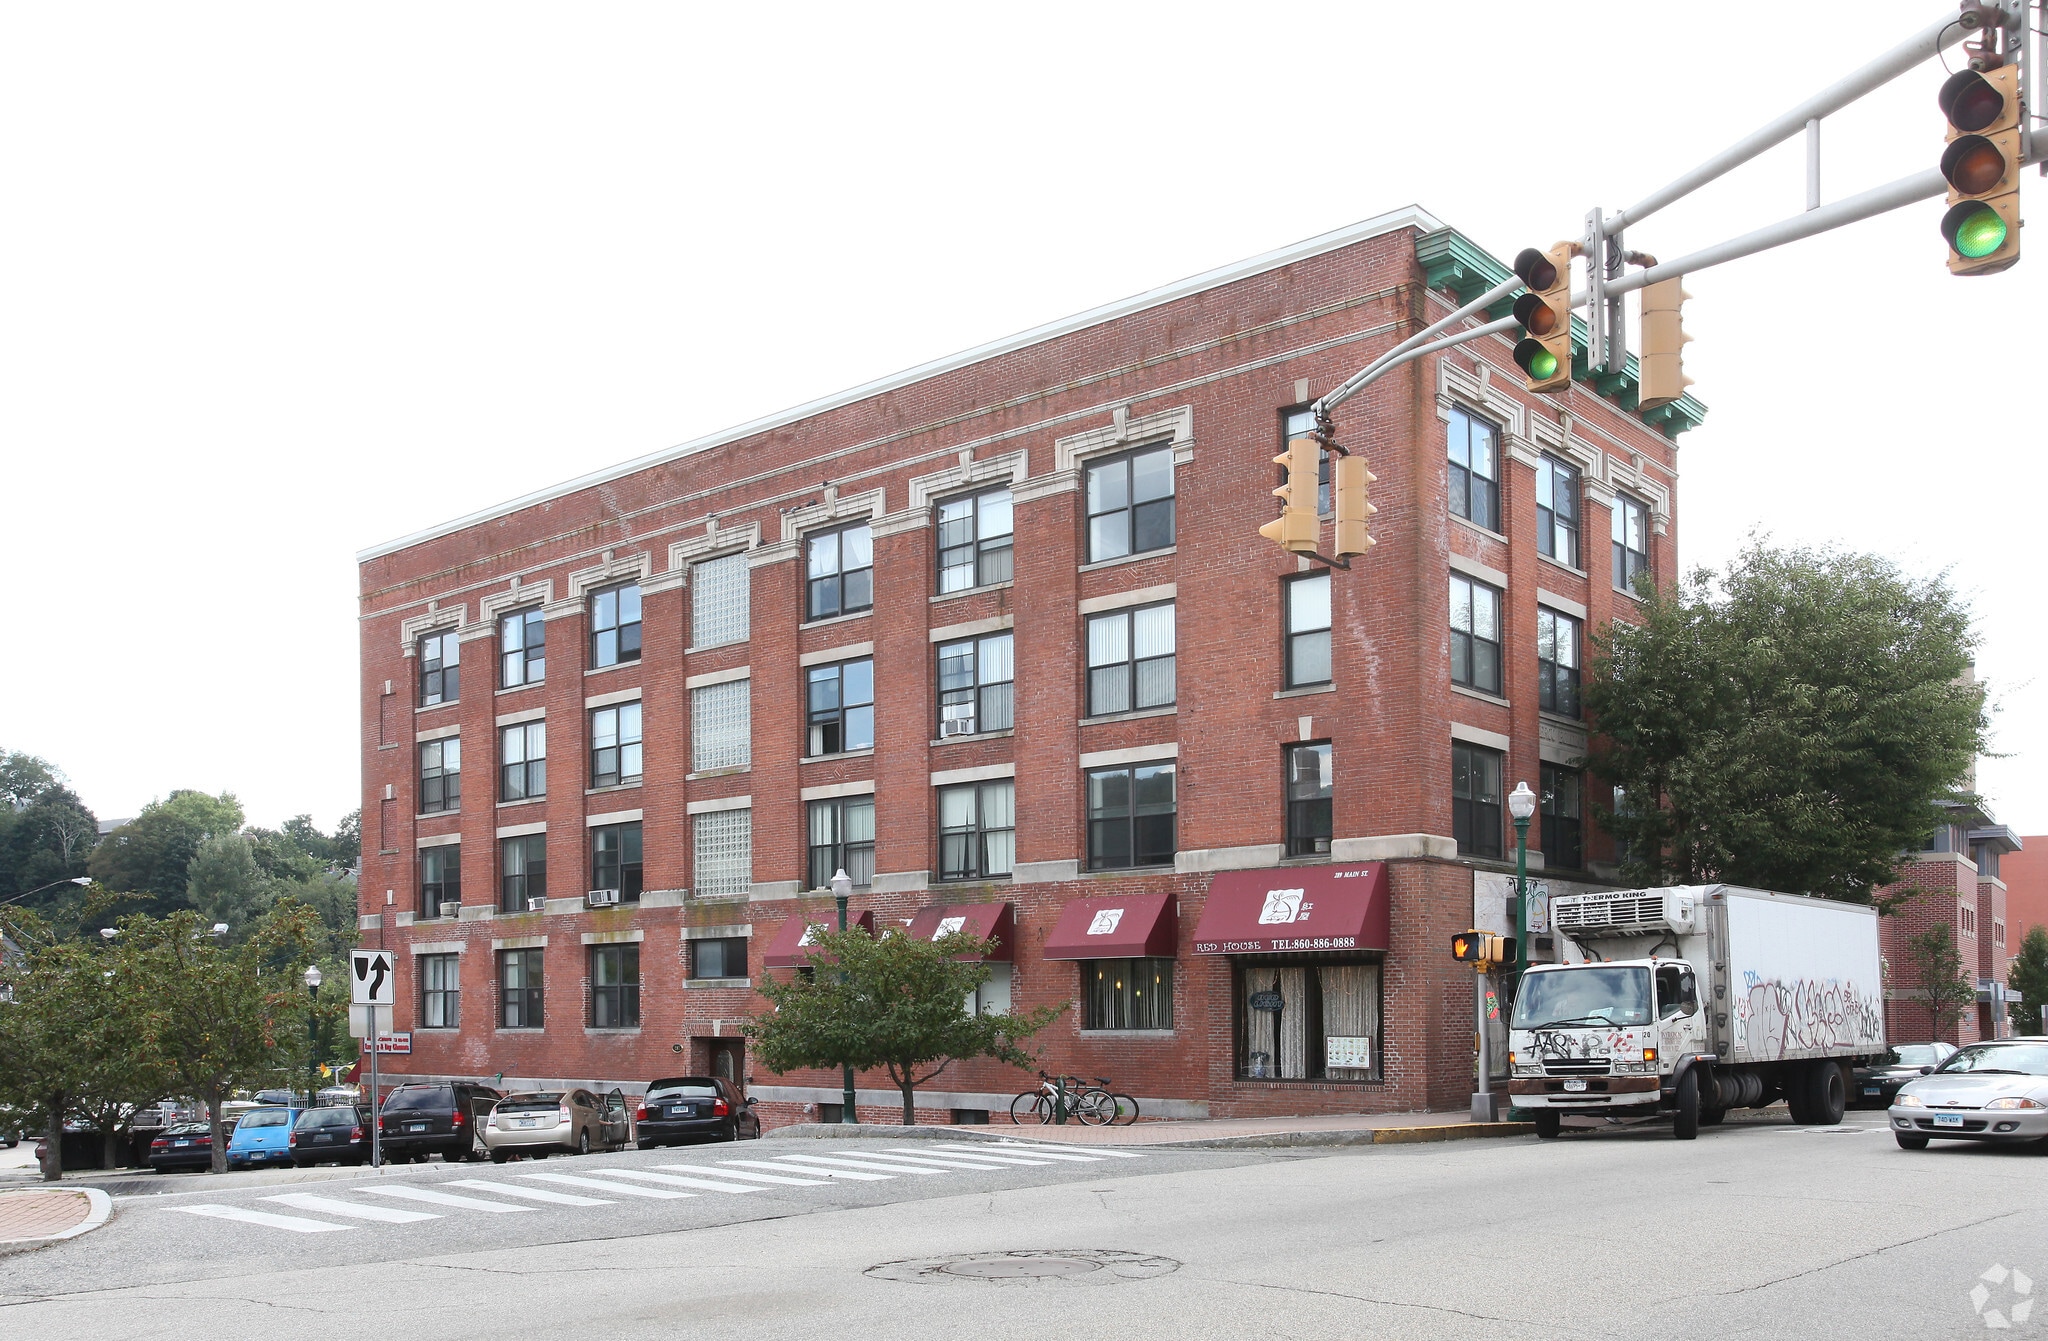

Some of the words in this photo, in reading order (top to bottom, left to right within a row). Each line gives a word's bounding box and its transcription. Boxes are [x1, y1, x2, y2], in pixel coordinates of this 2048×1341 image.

[1622, 891, 1647, 899] KING
[1196, 942, 1218, 952] RED
[1222, 940, 1261, 952] HOUSE
[1271, 936, 1355, 950] TEL:860-886-0888
